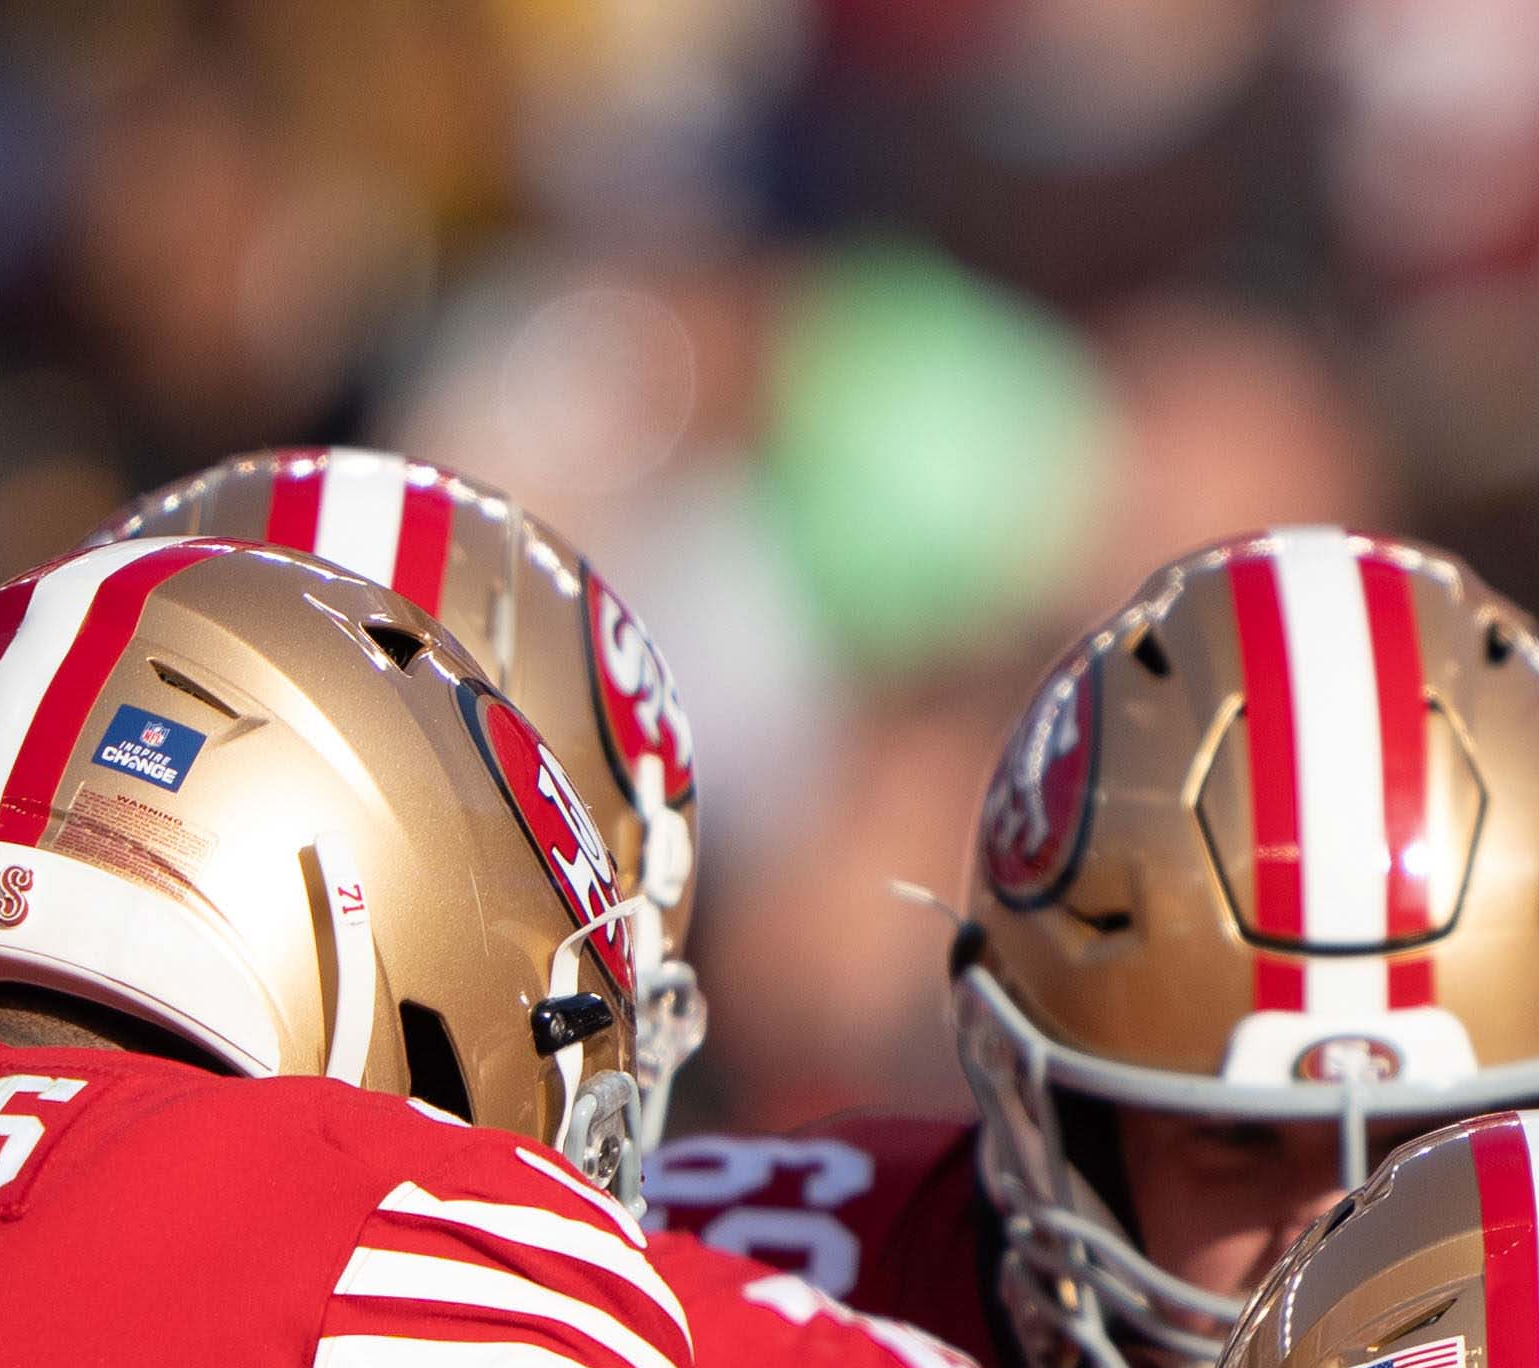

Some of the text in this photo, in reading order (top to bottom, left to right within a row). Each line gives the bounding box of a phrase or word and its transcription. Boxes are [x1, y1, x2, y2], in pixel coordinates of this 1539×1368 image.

[119, 740, 172, 766] INSPIRE
[116, 794, 184, 826] WARNING
[337, 884, 365, 914] 71
